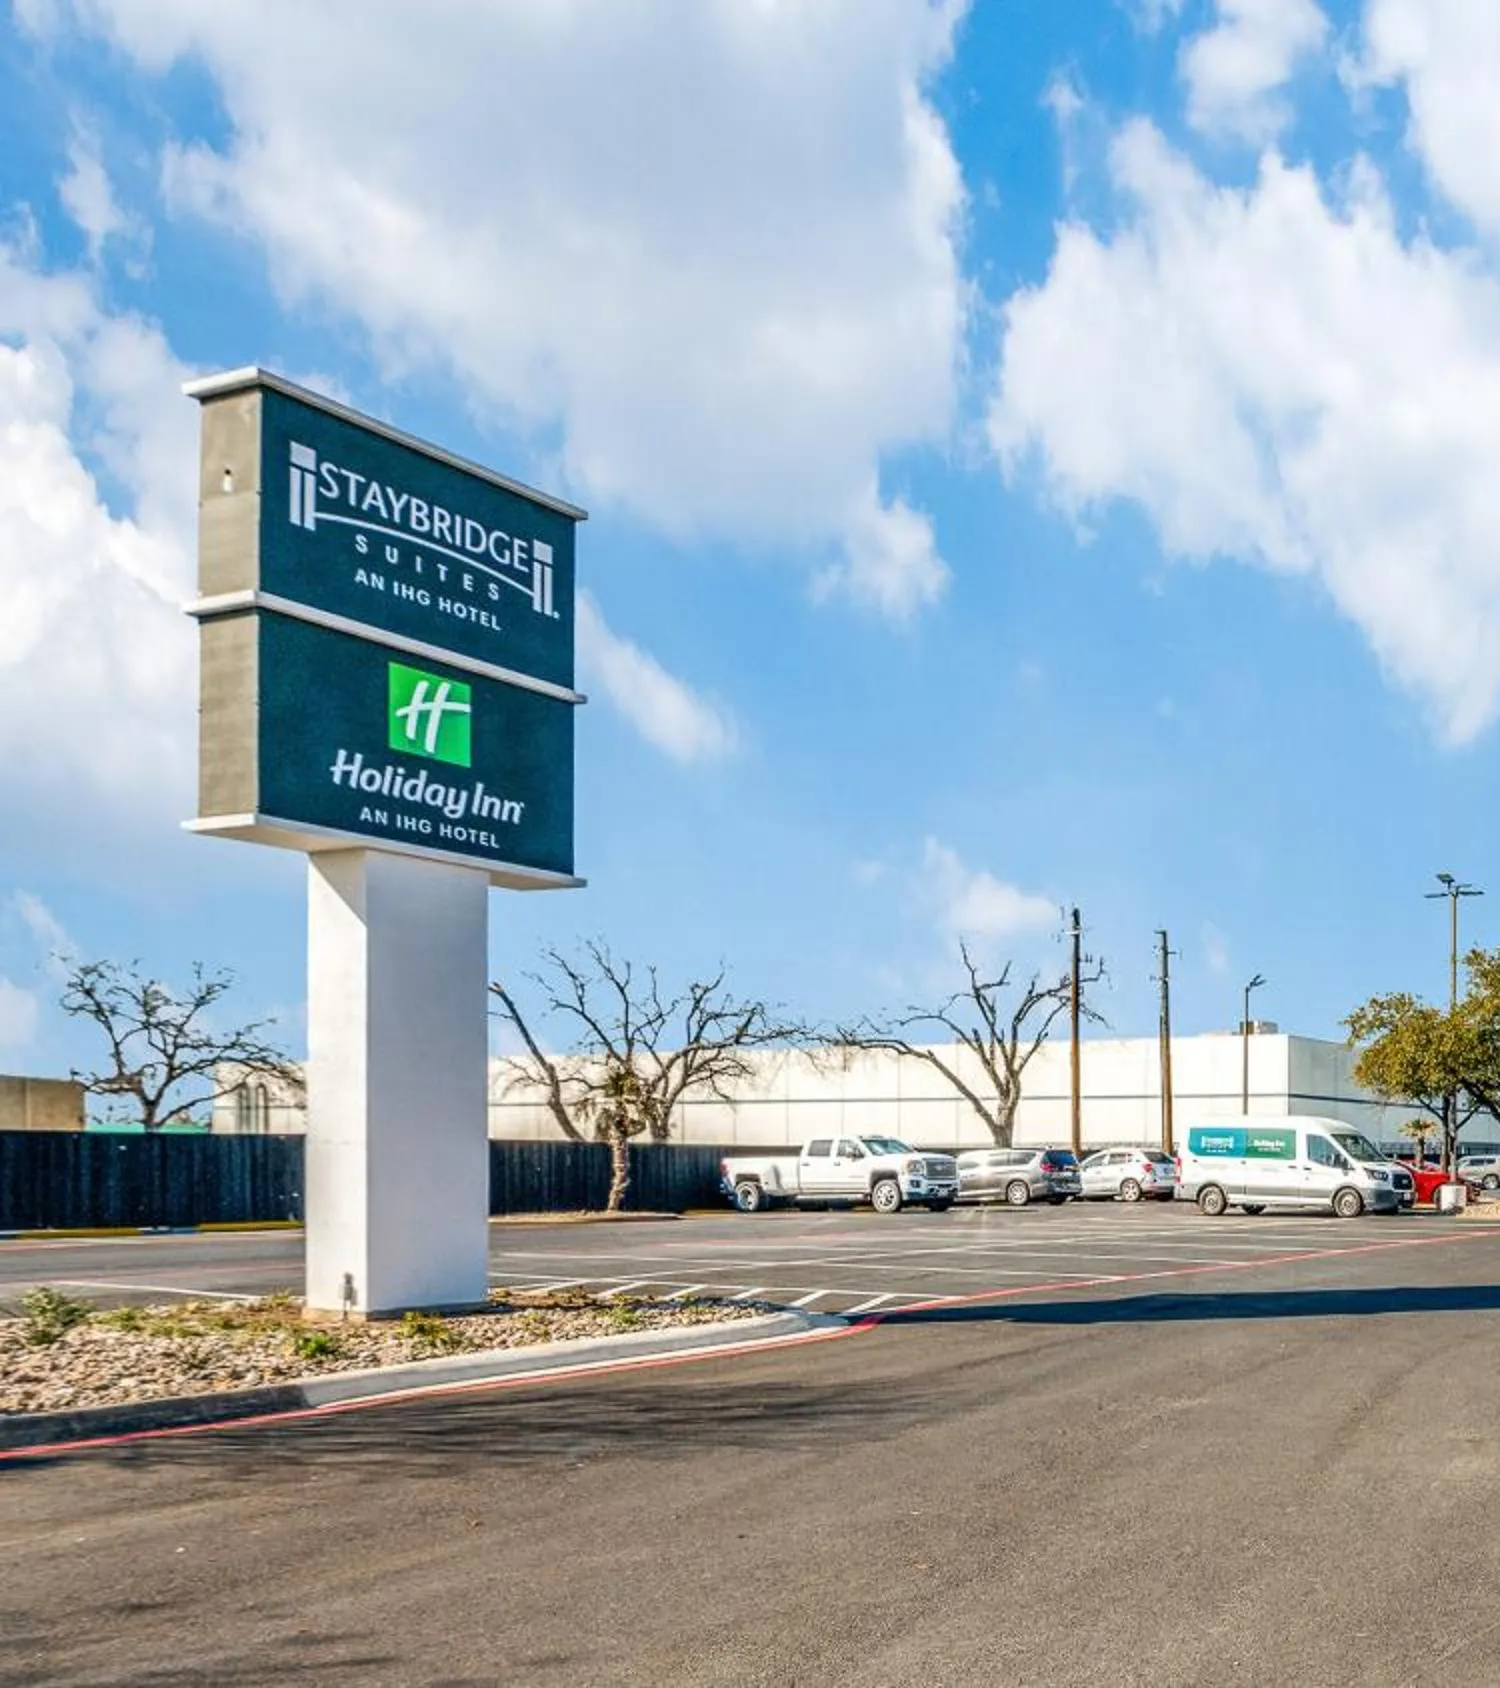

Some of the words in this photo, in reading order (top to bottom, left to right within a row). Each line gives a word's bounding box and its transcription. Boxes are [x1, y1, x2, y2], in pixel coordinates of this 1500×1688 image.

[319, 461, 529, 573] STAYBRIDGE
[354, 568, 385, 591] AN
[393, 581, 431, 606] IHG
[438, 596, 502, 631] HOTEL
[355, 533, 500, 600] SUITES
[329, 749, 468, 819] Holiday
[471, 781, 523, 825] Inn
[359, 806, 389, 826] AN
[396, 813, 433, 834] IHG
[439, 822, 500, 849] HOTEL
